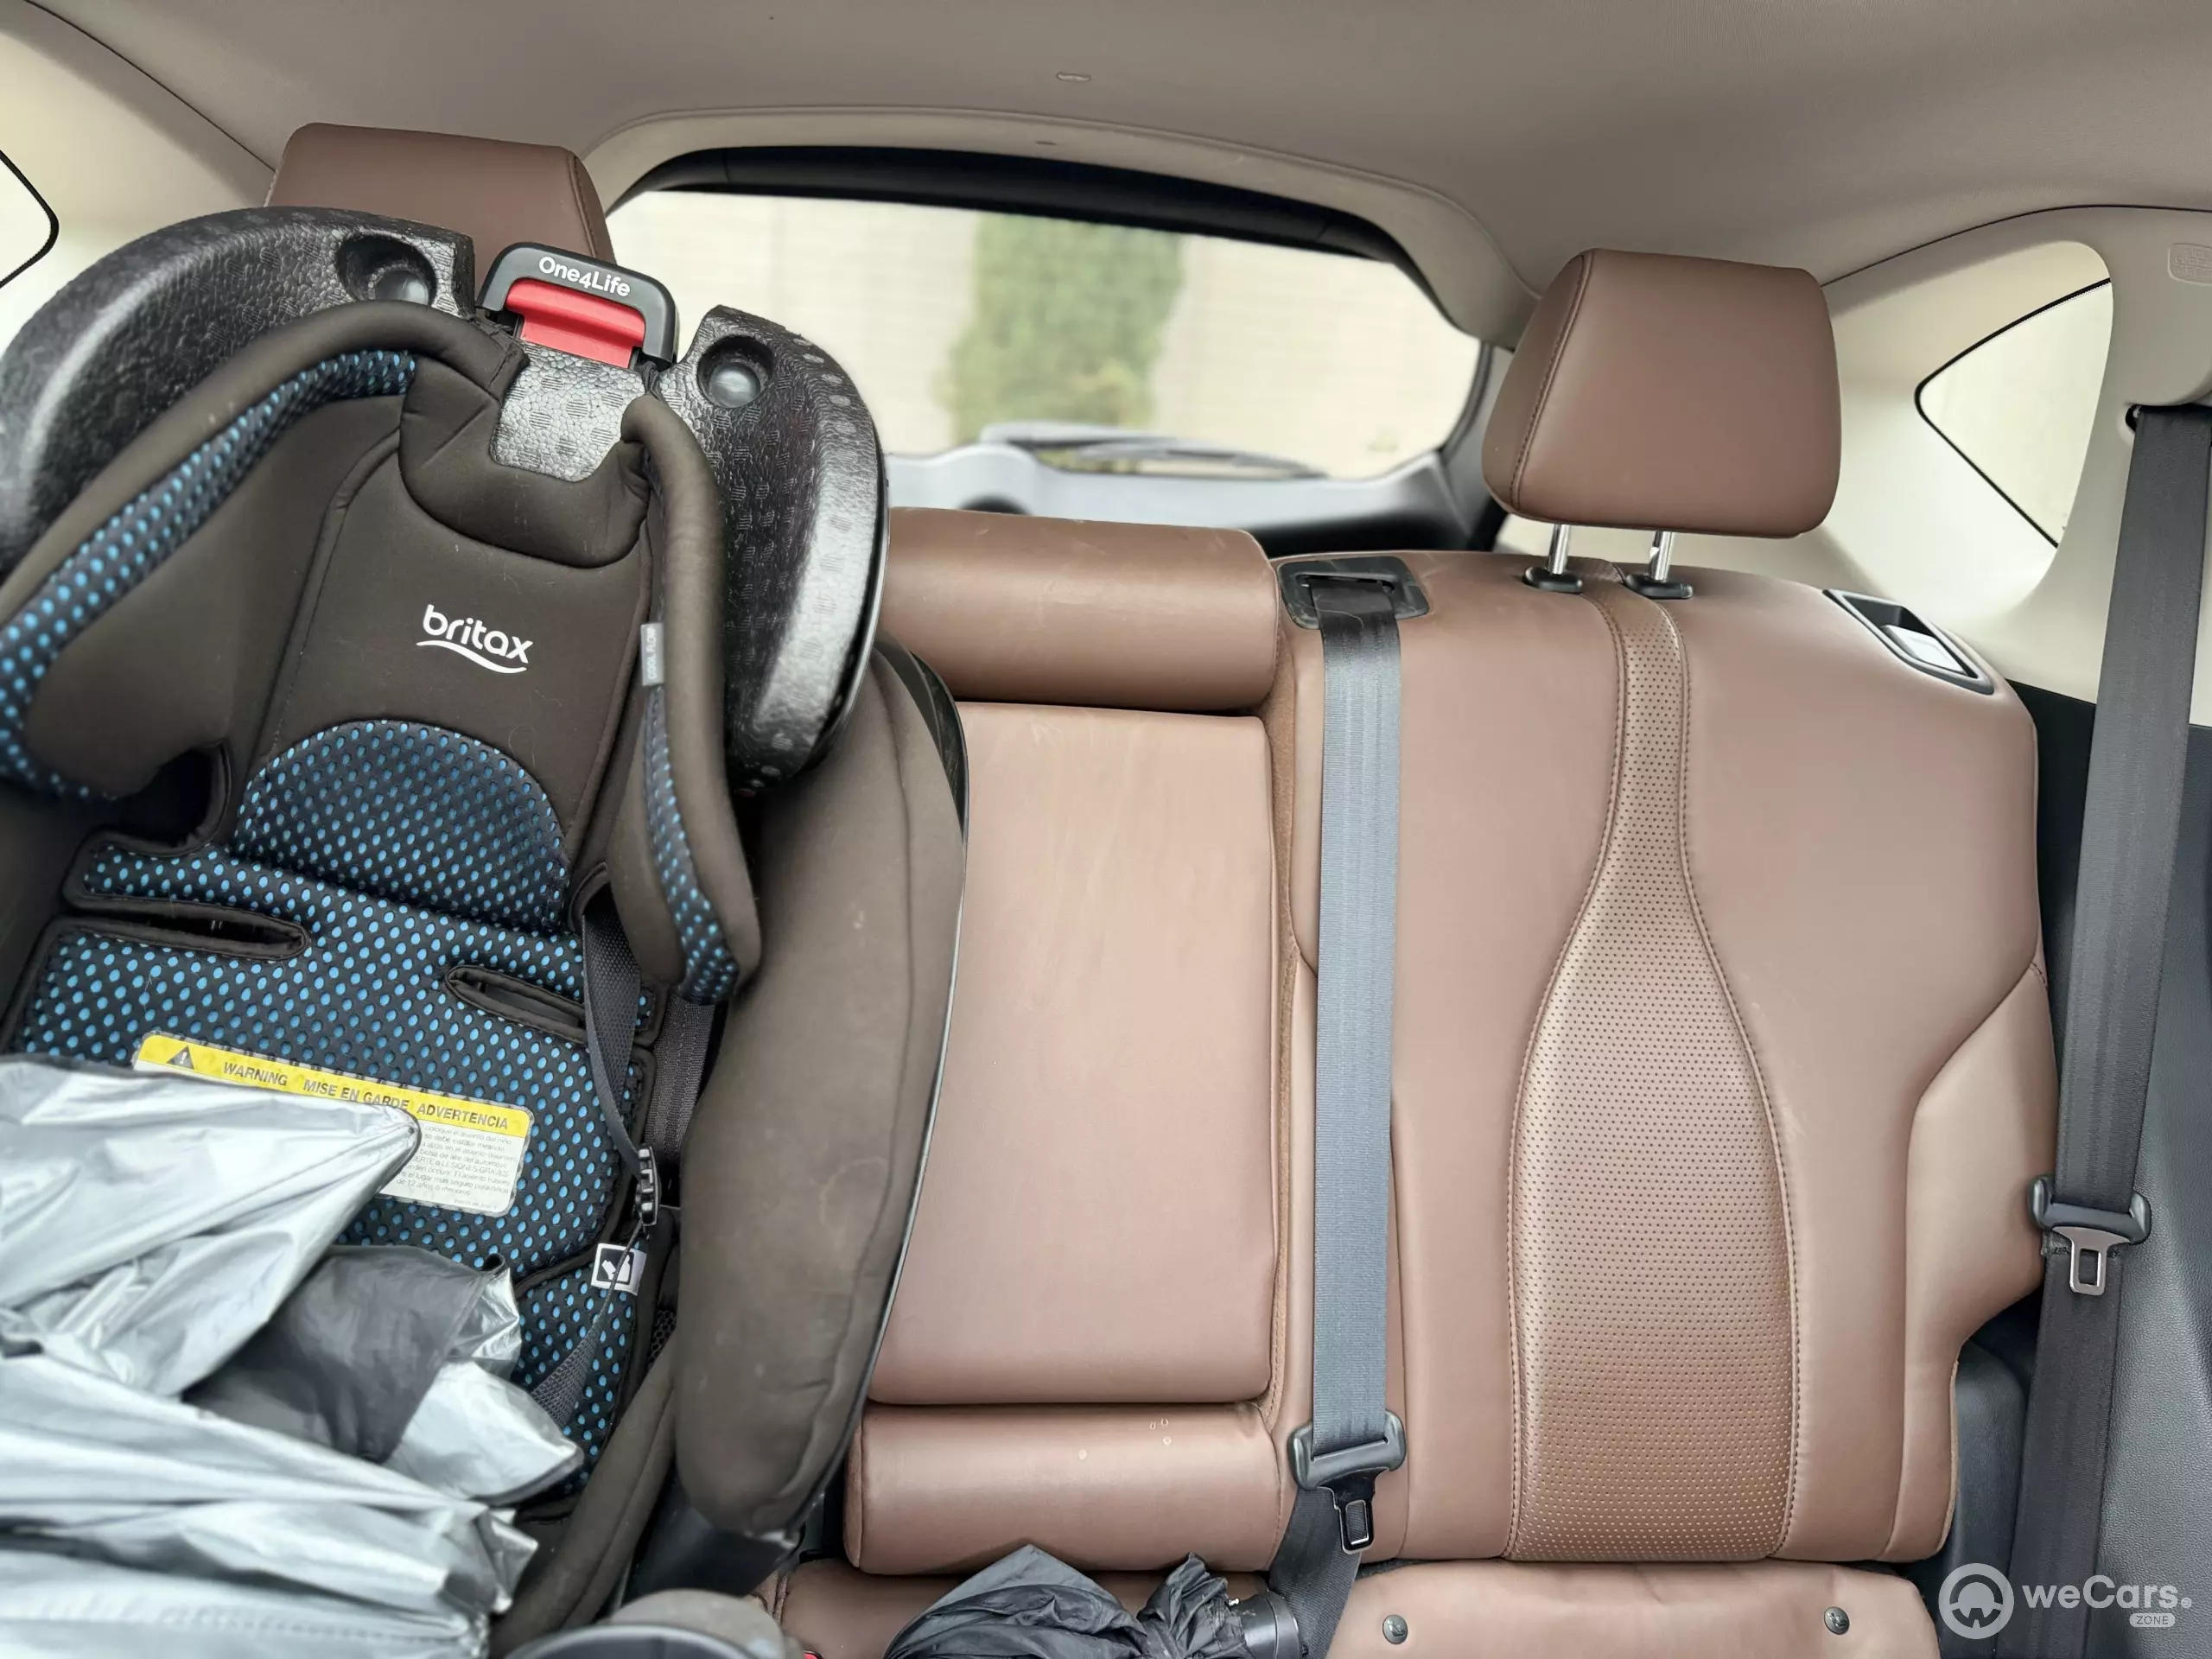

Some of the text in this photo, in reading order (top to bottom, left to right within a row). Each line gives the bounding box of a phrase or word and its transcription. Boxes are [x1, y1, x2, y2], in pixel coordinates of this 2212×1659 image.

[538, 256, 631, 296] One4Life
[423, 604, 534, 664] britax
[646, 654, 658, 680] COOL
[223, 1061, 508, 1130] WARNING MISE EN GARDE ADVERTENCIA
